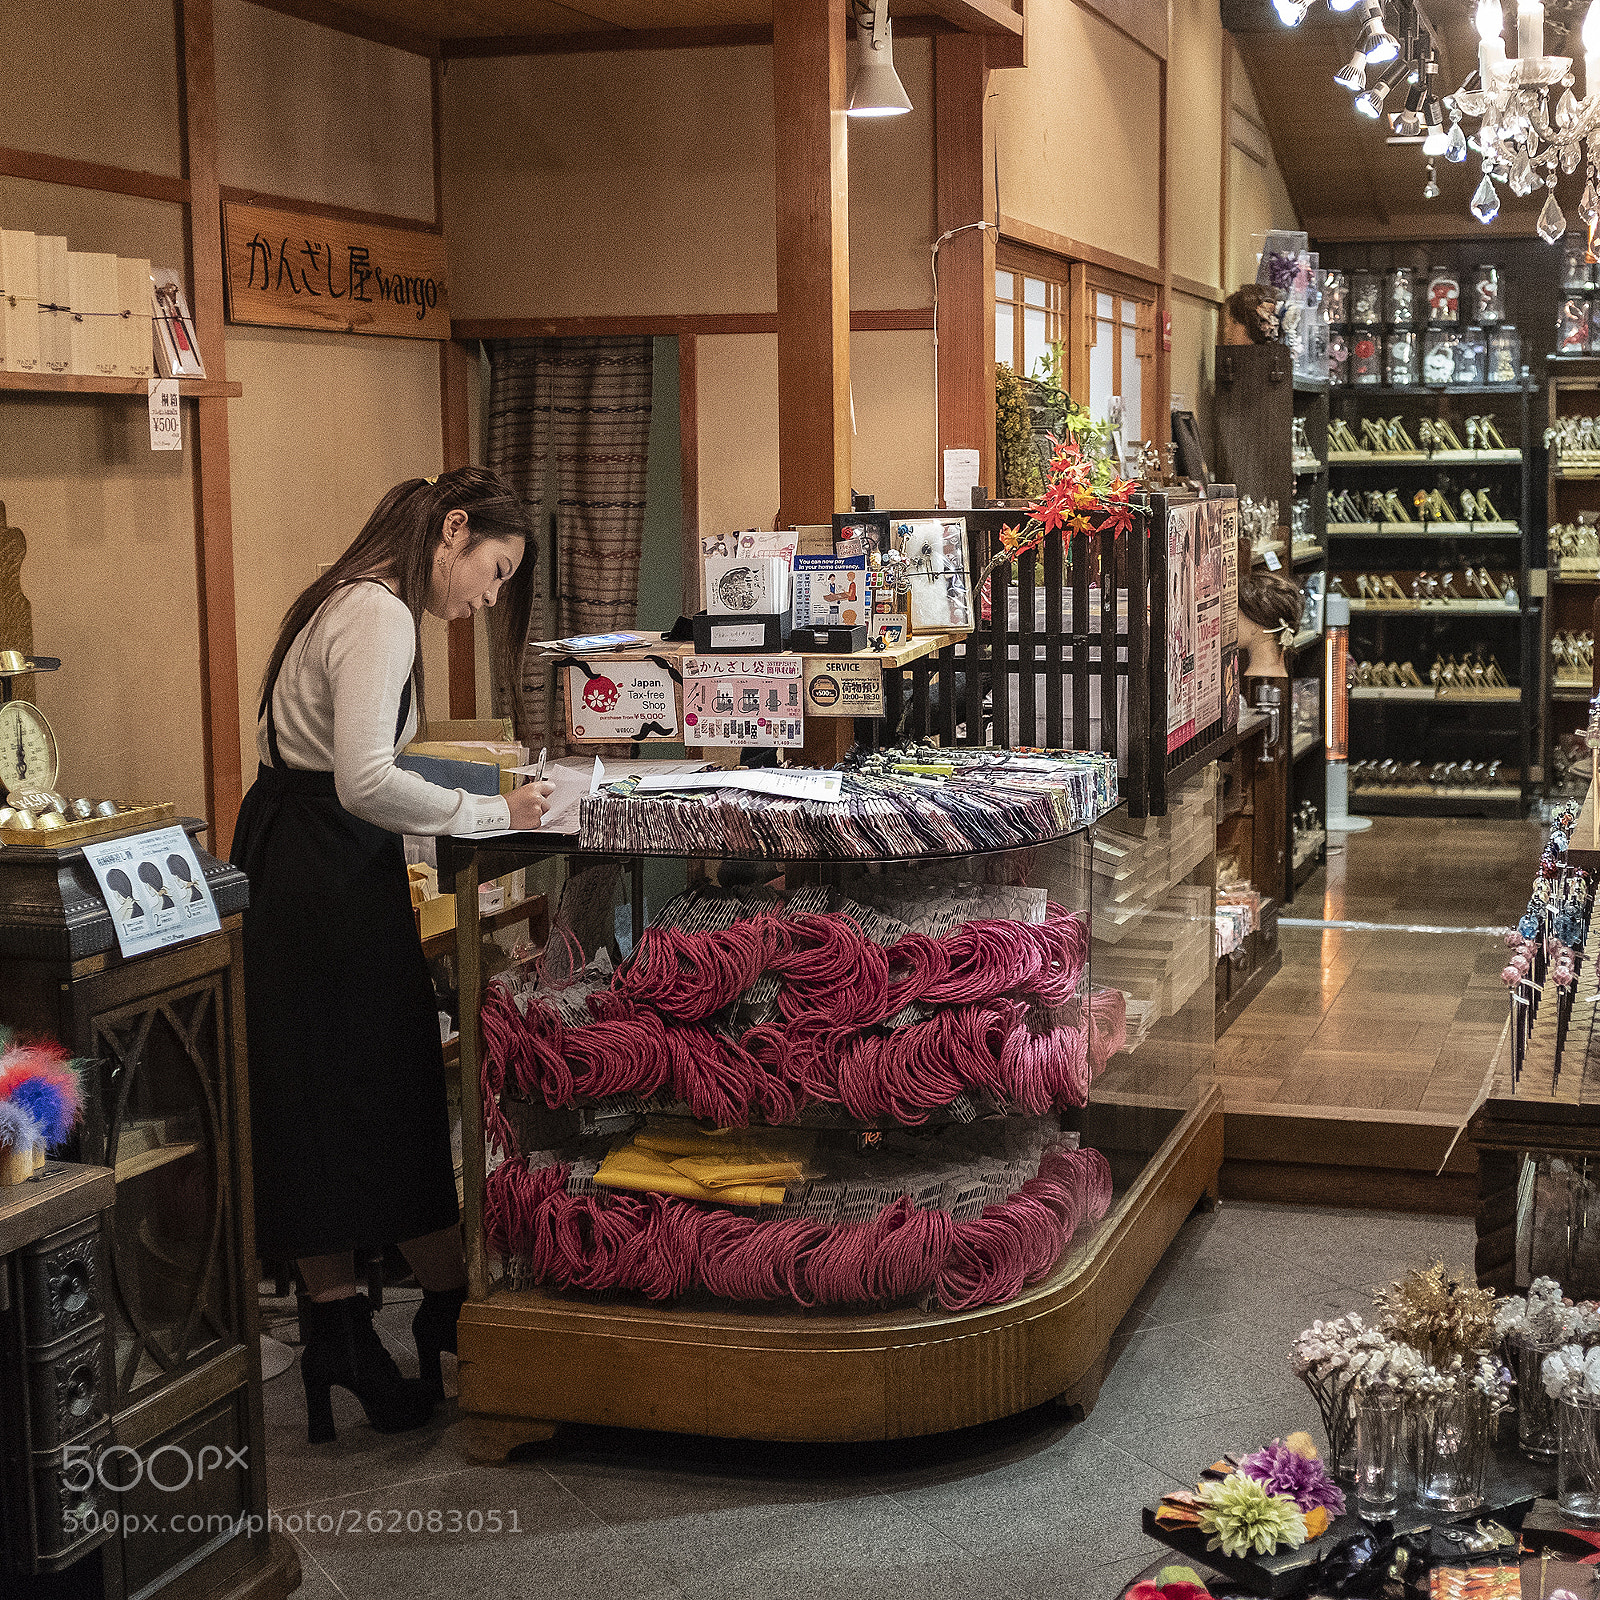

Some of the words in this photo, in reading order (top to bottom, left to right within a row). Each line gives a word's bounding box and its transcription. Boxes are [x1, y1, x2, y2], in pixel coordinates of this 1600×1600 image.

[246, 233, 372, 302] かんざし屋
[374, 266, 438, 320] wargo
[700, 660, 765, 674] かんざし袋
[825, 662, 860, 672] SERVICE
[628, 690, 665, 699] Tax-free
[642, 700, 666, 711] Shop
[184, 905, 192, 919] 3
[153, 913, 162, 927] 2
[122, 923, 129, 936] 1
